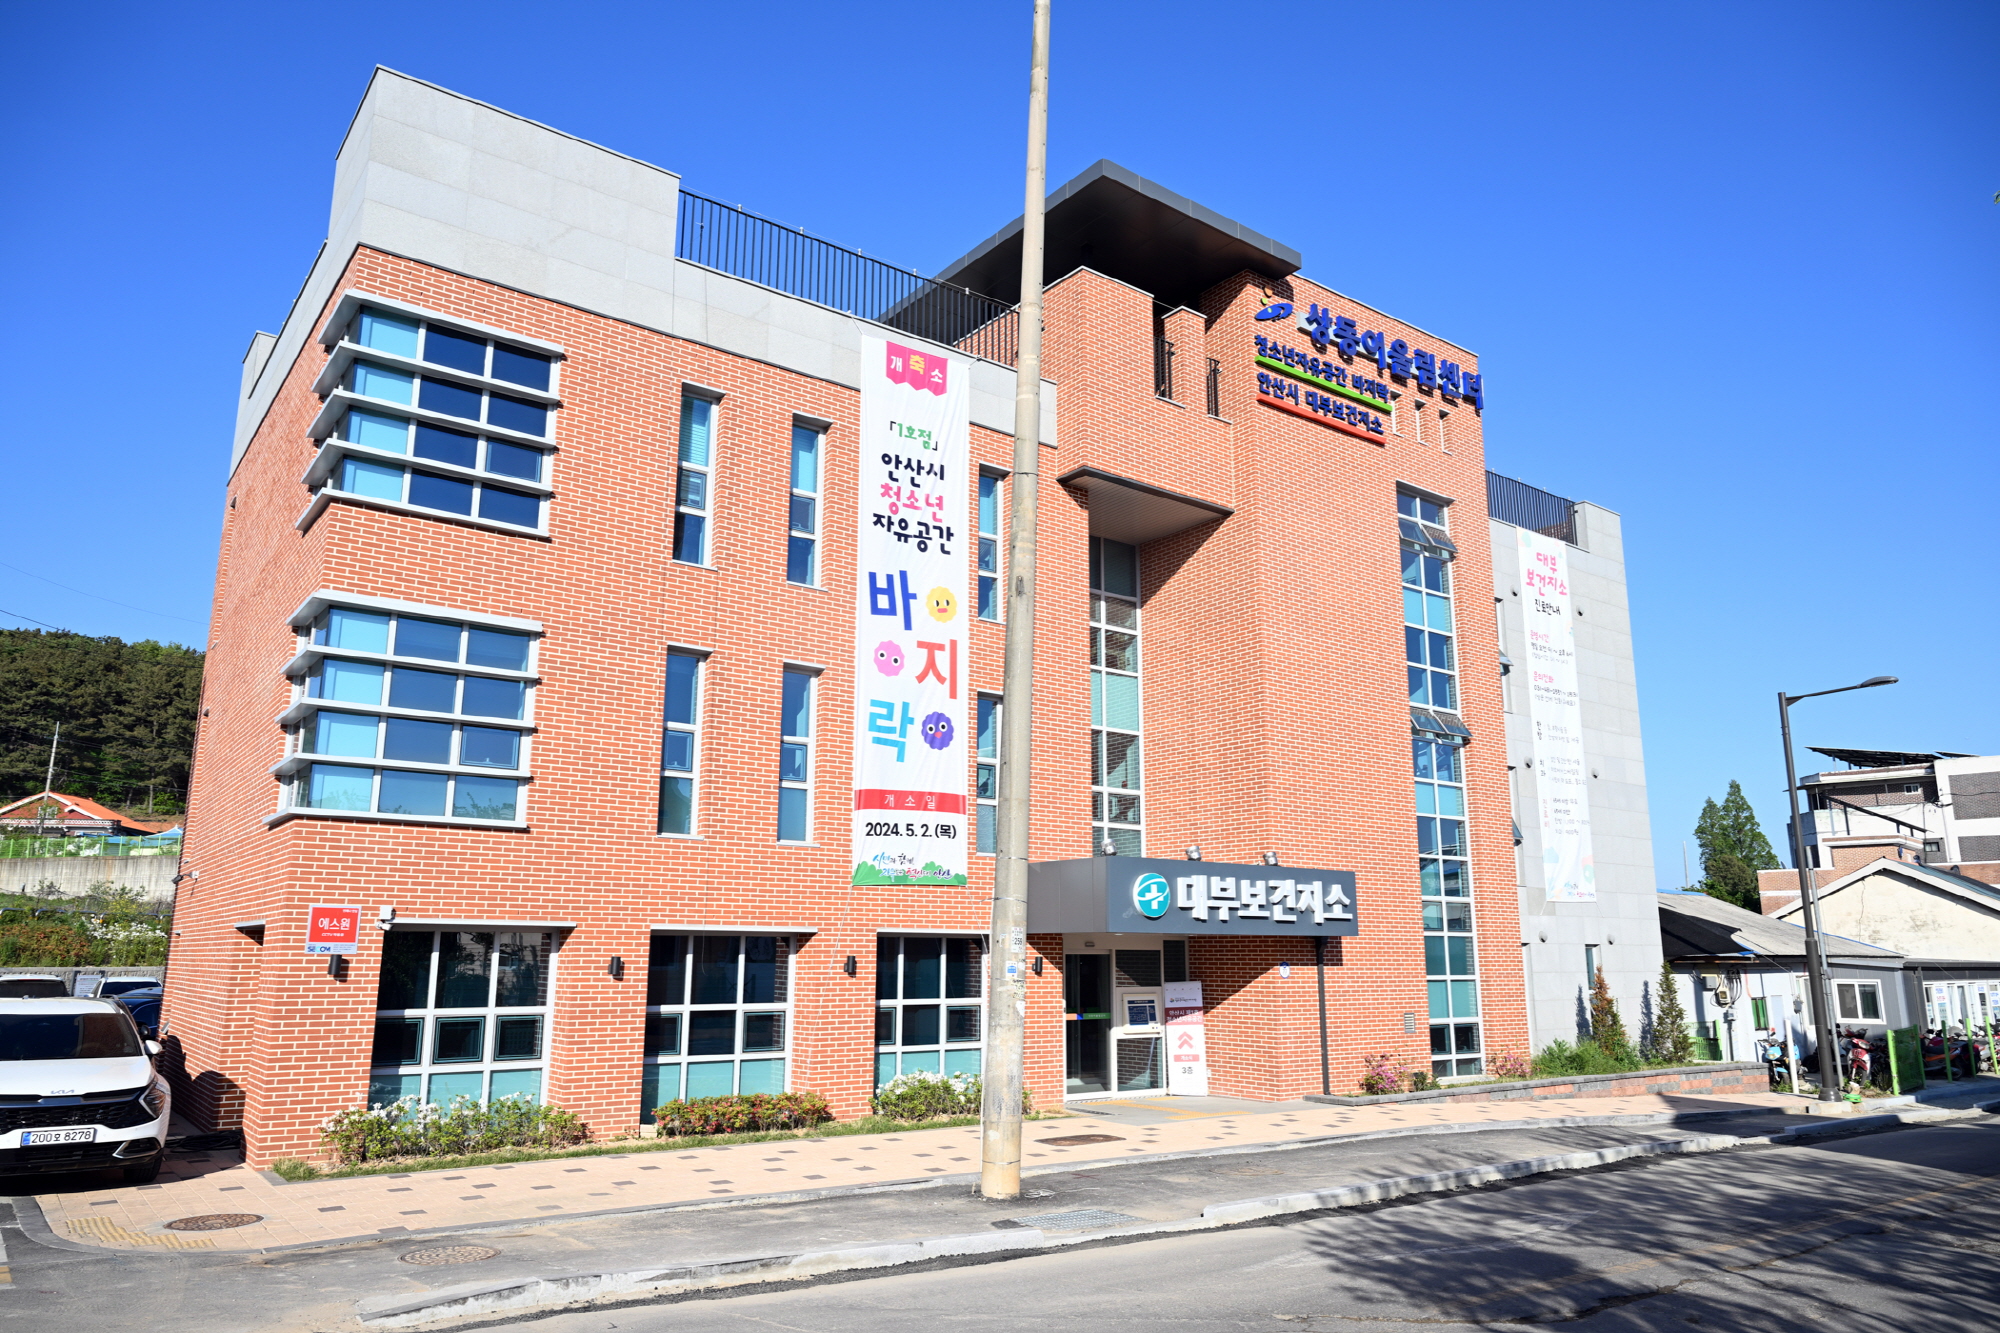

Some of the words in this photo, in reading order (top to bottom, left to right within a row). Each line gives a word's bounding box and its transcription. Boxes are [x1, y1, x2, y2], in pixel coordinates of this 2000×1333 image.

[1254, 334, 1347, 388] 청소년자유공간
[1352, 374, 1390, 403] 바지락
[1306, 303, 1484, 410] 상동어울림센터
[1257, 372, 1299, 405] 안산시
[1306, 390, 1384, 434] 대부보건지소
[881, 452, 945, 488] 안산시
[880, 482, 944, 523] 청소년
[872, 512, 954, 555] 자유공간
[1526, 567, 1568, 597] 보건지소
[1536, 551, 1557, 575] 대부
[868, 570, 917, 631] 바
[914, 638, 958, 700] 지
[867, 699, 915, 763] 락
[884, 793, 936, 810] 개소일
[1177, 874, 1353, 924] 대부보건지소
[318, 917, 351, 931] 에스원
[1181, 1066, 1194, 1075] 3층
[64, 1130, 92, 1142] 8278
